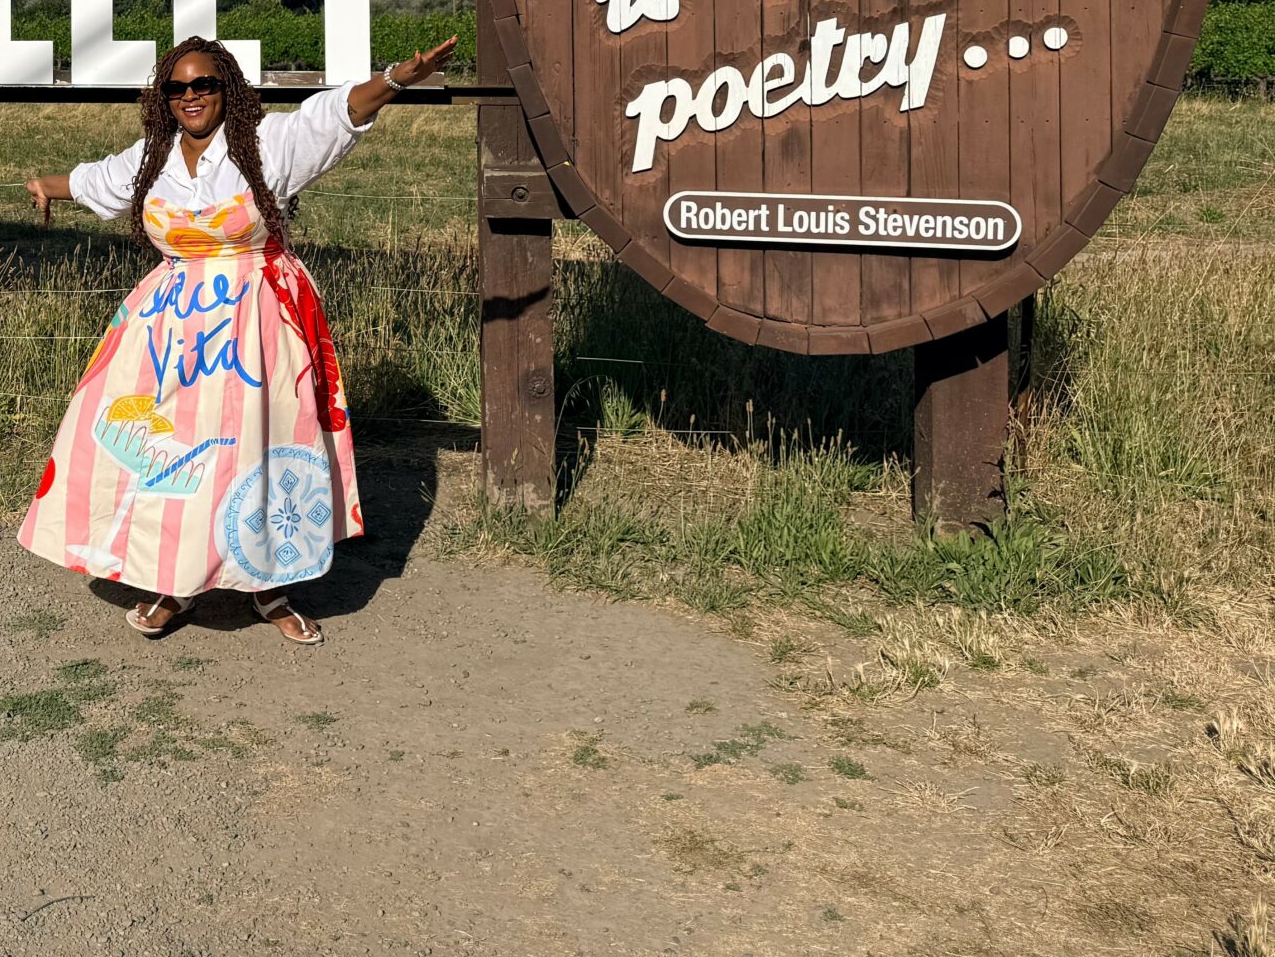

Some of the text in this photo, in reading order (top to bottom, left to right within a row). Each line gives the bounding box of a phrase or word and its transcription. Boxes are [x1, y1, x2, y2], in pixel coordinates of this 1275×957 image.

[679, 200, 1005, 241] Robert Louis Stevenson
